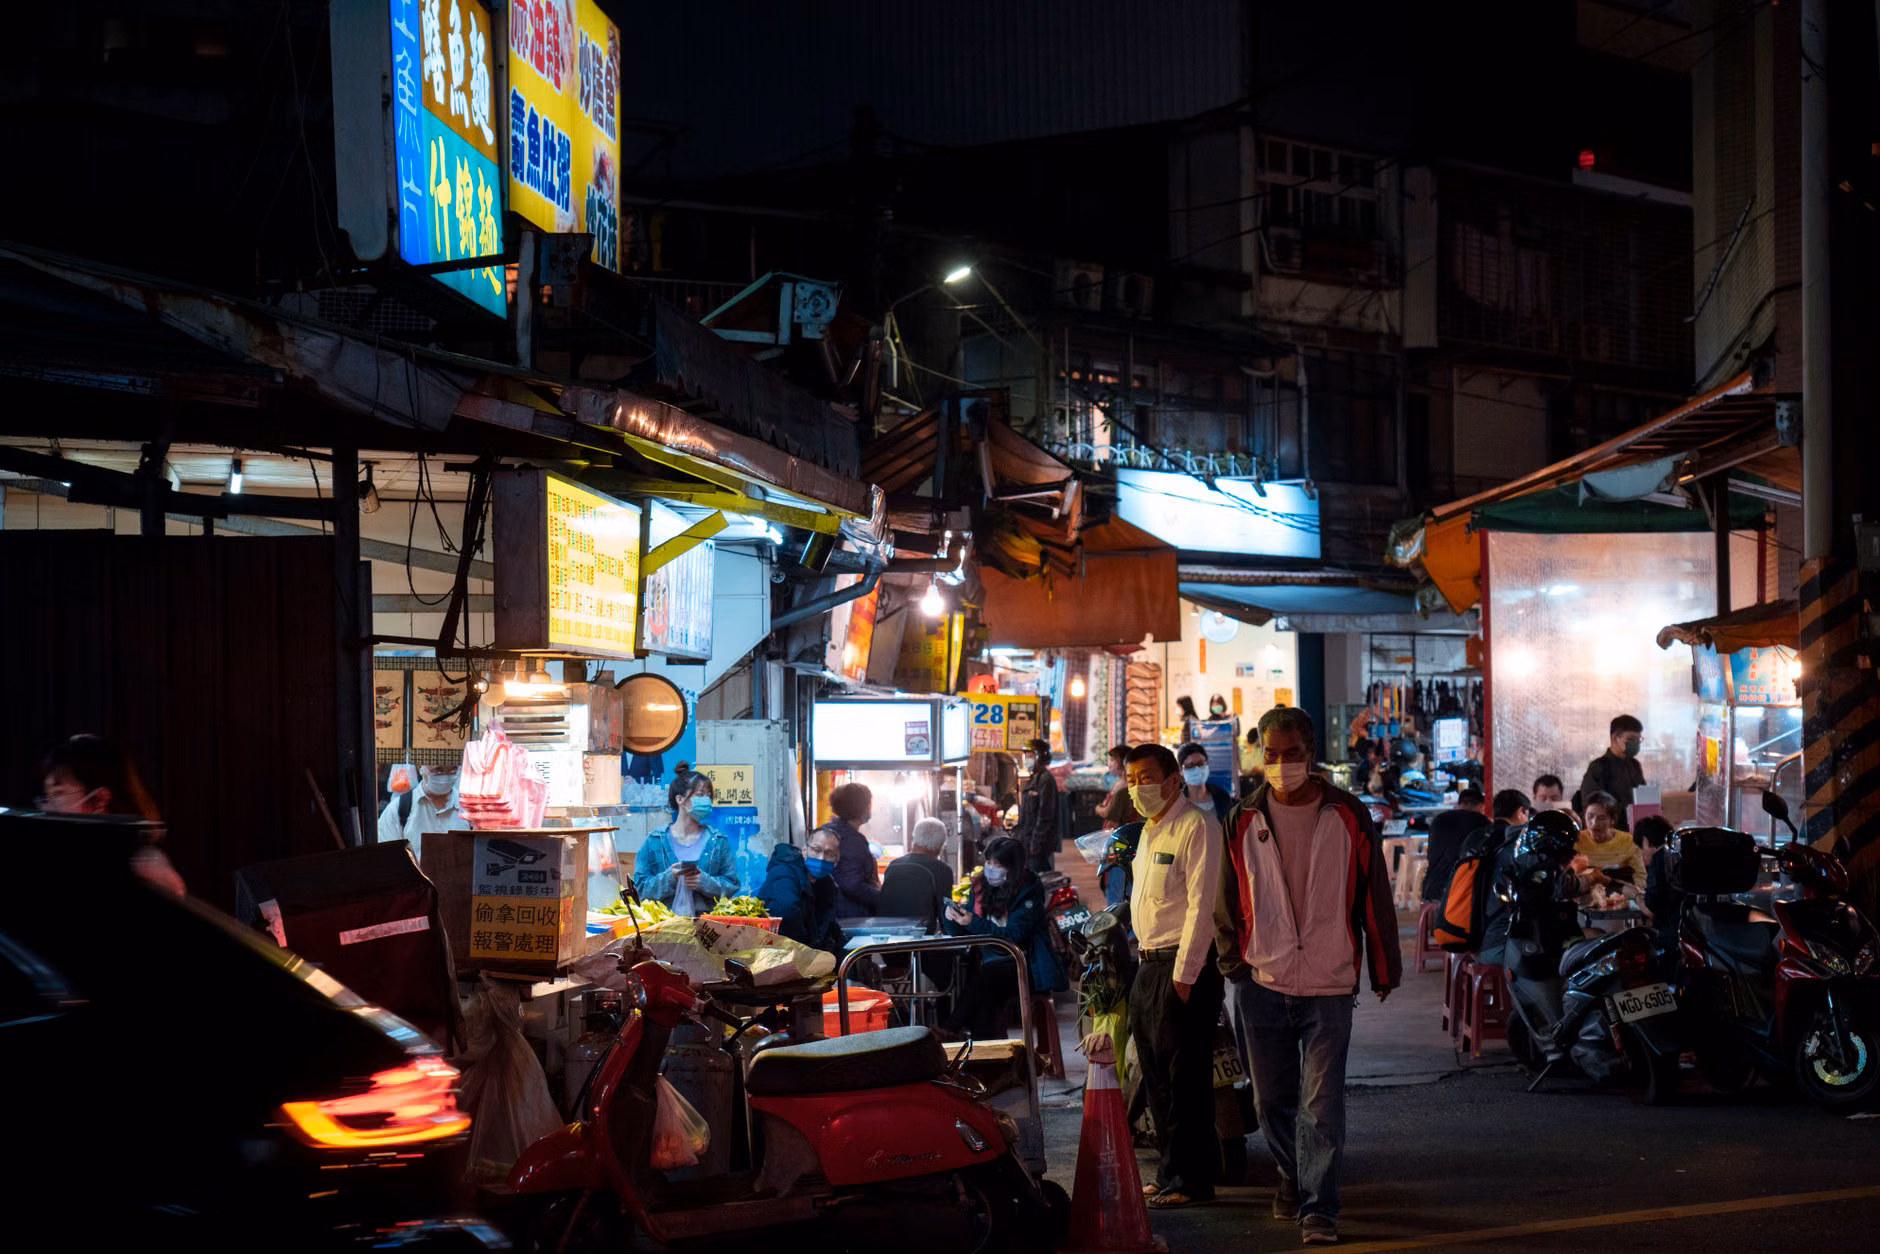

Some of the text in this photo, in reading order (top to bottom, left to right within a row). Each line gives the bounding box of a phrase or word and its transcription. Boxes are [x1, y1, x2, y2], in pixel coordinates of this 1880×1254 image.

[971, 703, 1003, 724] 28
[972, 728, 1003, 749] 仔煎
[478, 884, 554, 897] 監視錄影中
[475, 902, 557, 926] 偷拿回收
[473, 930, 555, 954] 報警處理
